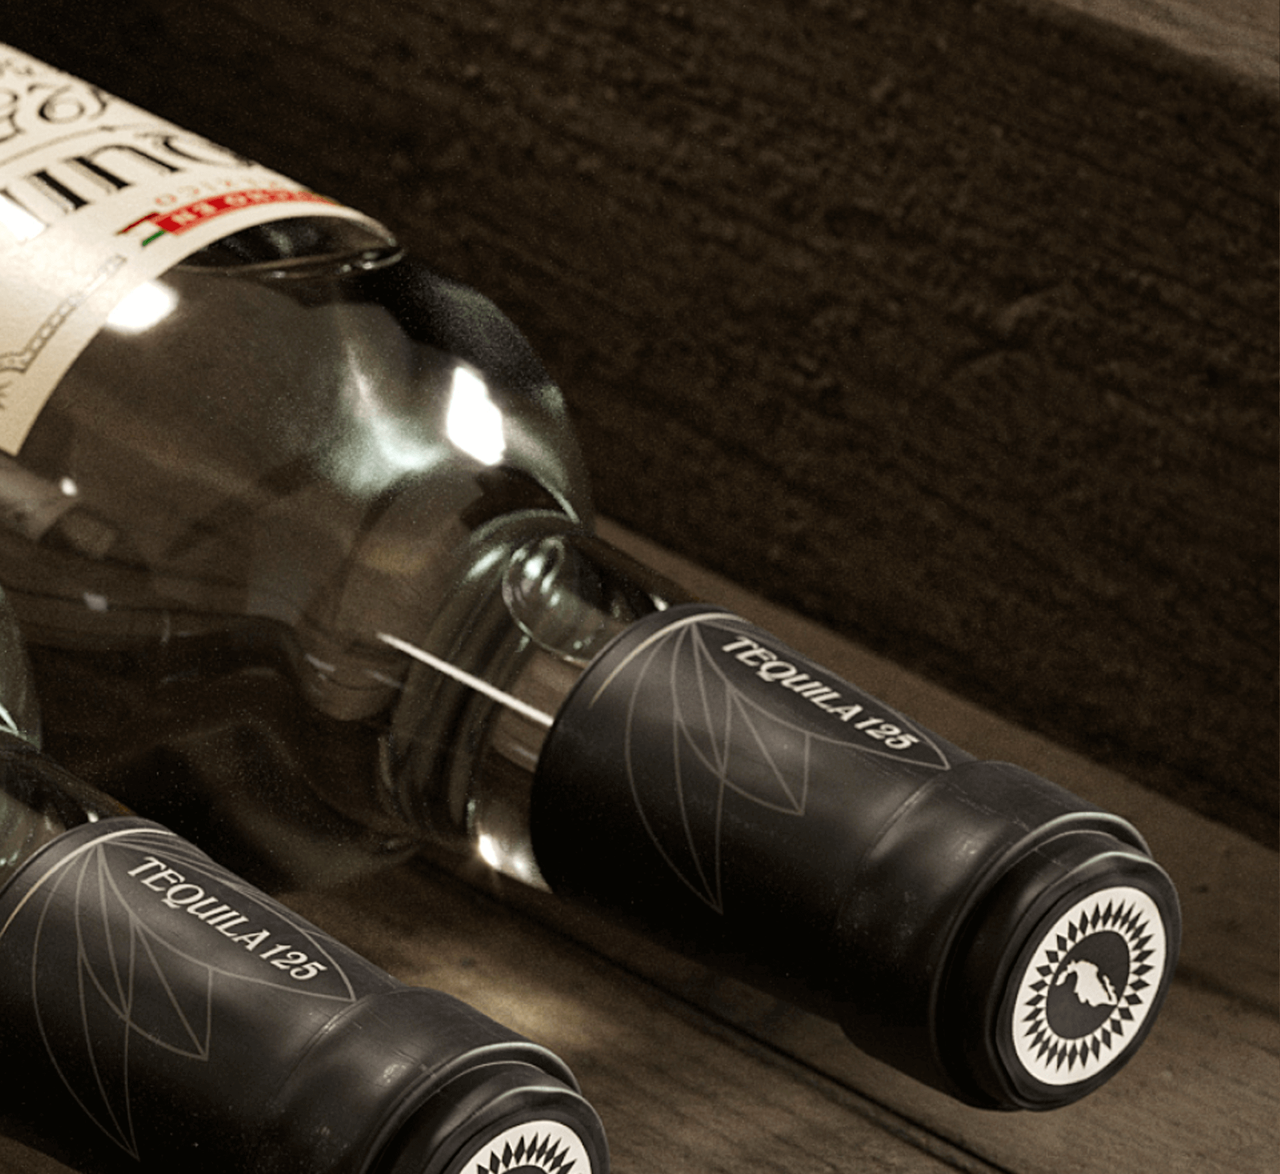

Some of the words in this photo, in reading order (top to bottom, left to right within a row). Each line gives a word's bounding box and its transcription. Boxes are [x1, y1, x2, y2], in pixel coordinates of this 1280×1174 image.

[722, 635, 864, 722] TEQUILA
[854, 716, 921, 750] 125
[127, 856, 271, 951] TEQUILA
[259, 943, 328, 981] 125
